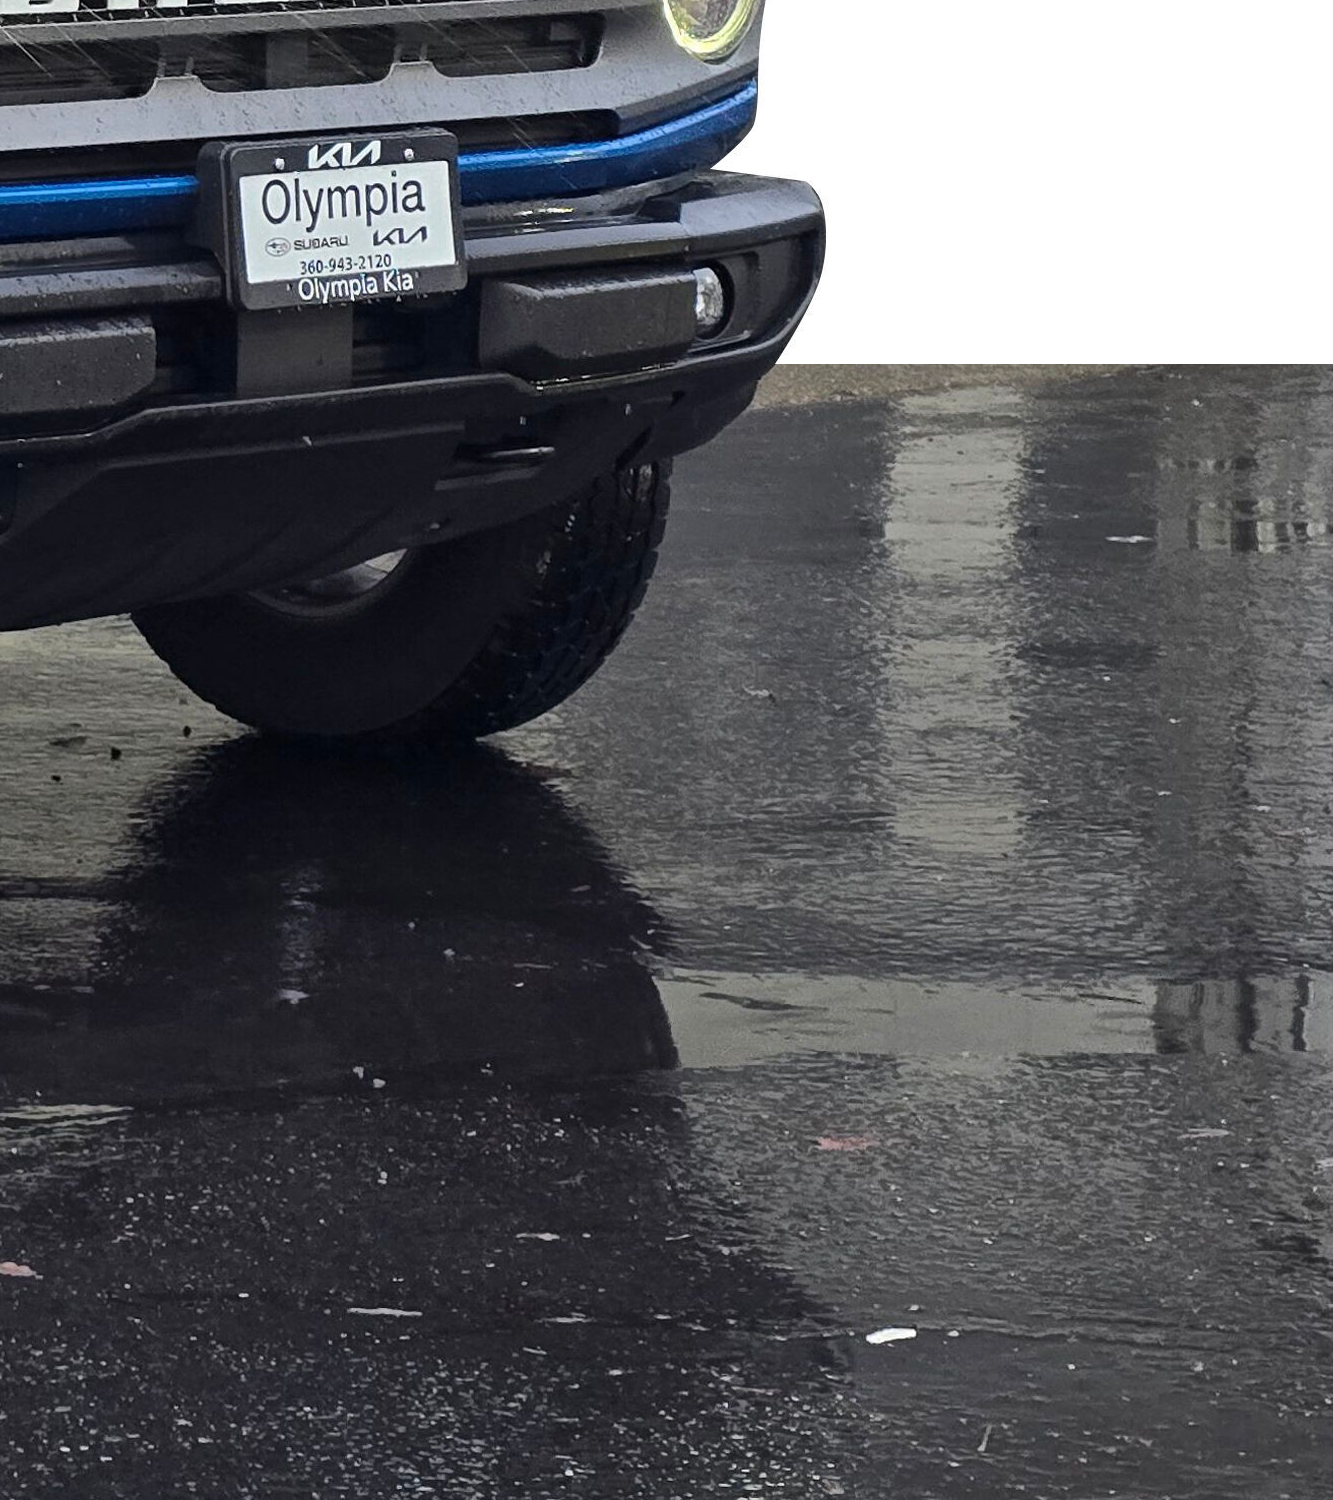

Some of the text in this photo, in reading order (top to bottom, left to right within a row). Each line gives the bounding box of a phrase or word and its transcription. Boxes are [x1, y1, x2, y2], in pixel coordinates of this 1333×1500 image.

[308, 140, 381, 169] KIA
[261, 170, 426, 233] Olympia
[293, 236, 349, 251] SUBARU
[372, 226, 428, 247] KIA
[299, 254, 392, 275] 360-943-2120
[298, 269, 415, 304] Olympia Kia
